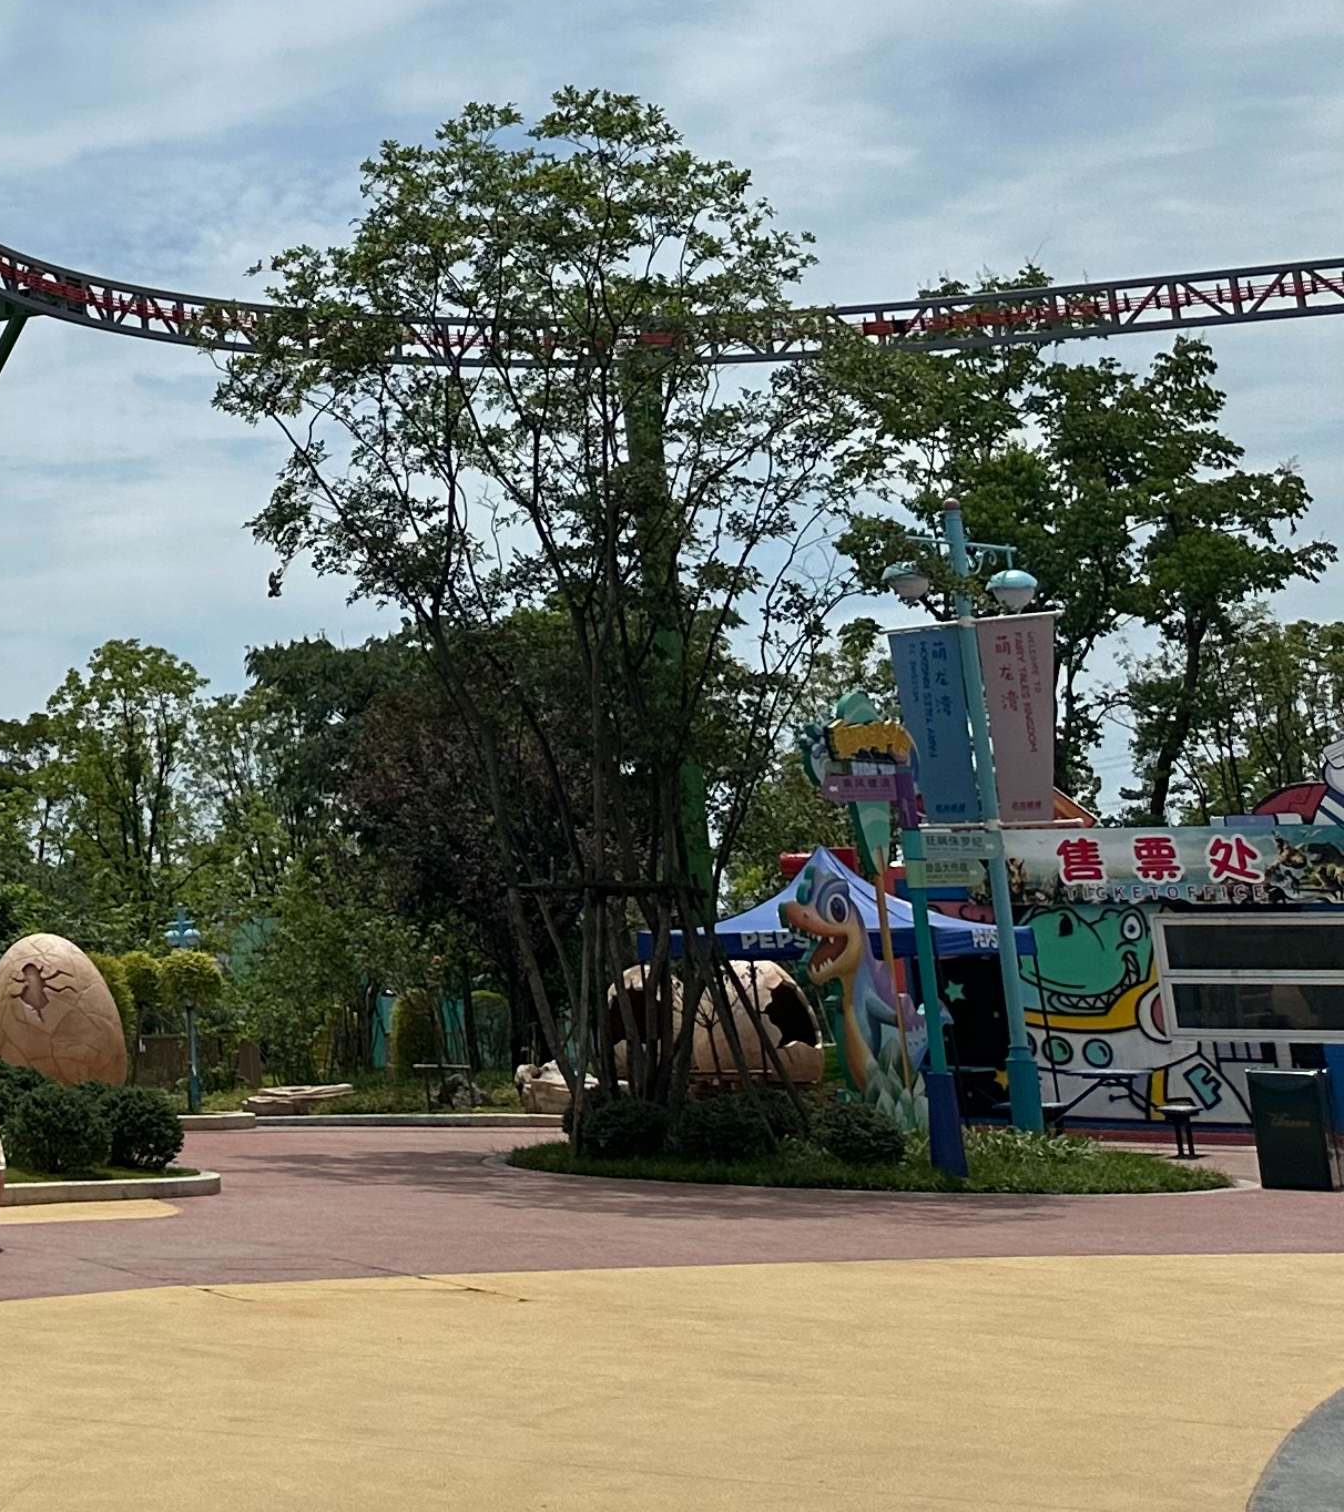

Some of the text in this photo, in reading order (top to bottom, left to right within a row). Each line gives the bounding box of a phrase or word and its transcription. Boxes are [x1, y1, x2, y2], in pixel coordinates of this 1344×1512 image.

[1055, 835, 1262, 882] 售票处
[740, 931, 812, 949] PEPS
